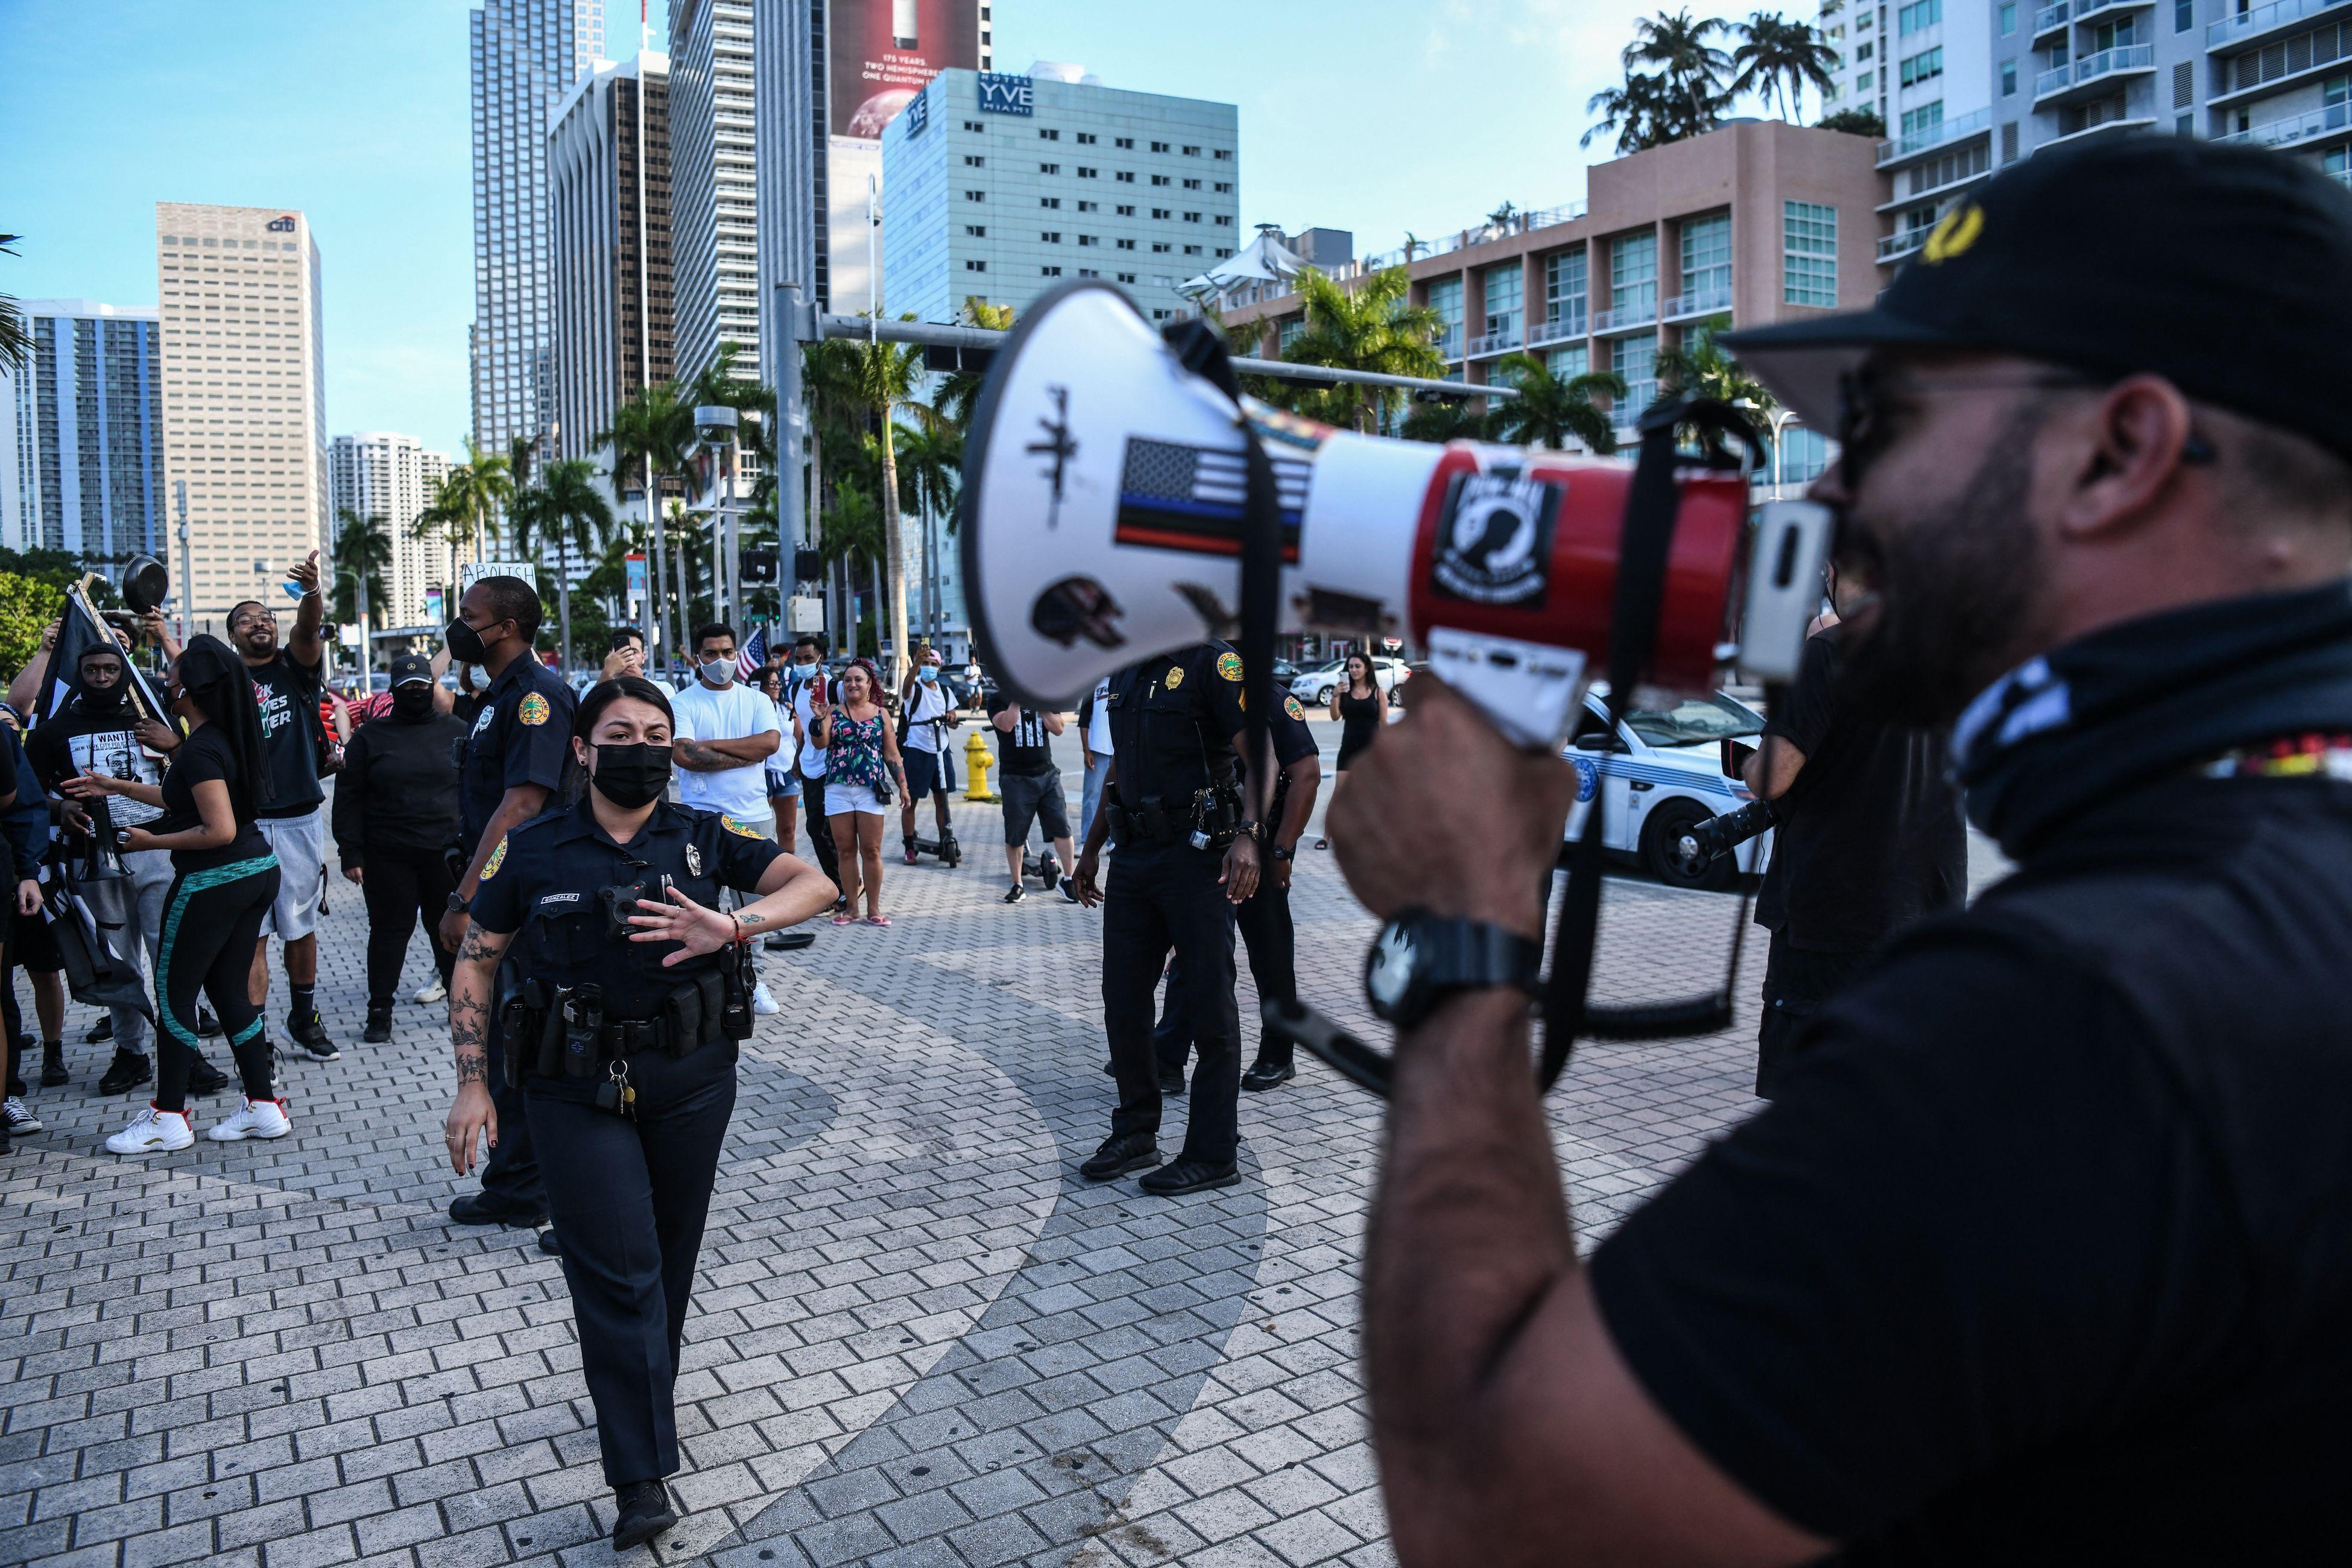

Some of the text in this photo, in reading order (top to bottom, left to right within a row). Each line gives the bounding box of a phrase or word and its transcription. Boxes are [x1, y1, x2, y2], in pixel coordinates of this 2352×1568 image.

[864, 61, 885, 71] TWO
[862, 71, 880, 80] ONE
[882, 74, 925, 85] QUANTUM
[981, 74, 1029, 86] HOTEL
[979, 81, 1032, 107] YVE
[983, 103, 1029, 114] MIAMI
[269, 217, 295, 232] citi
[537, 696, 549, 710] MIAMI
[98, 732, 136, 742] WANTD
[496, 845, 507, 867] MIAMI
